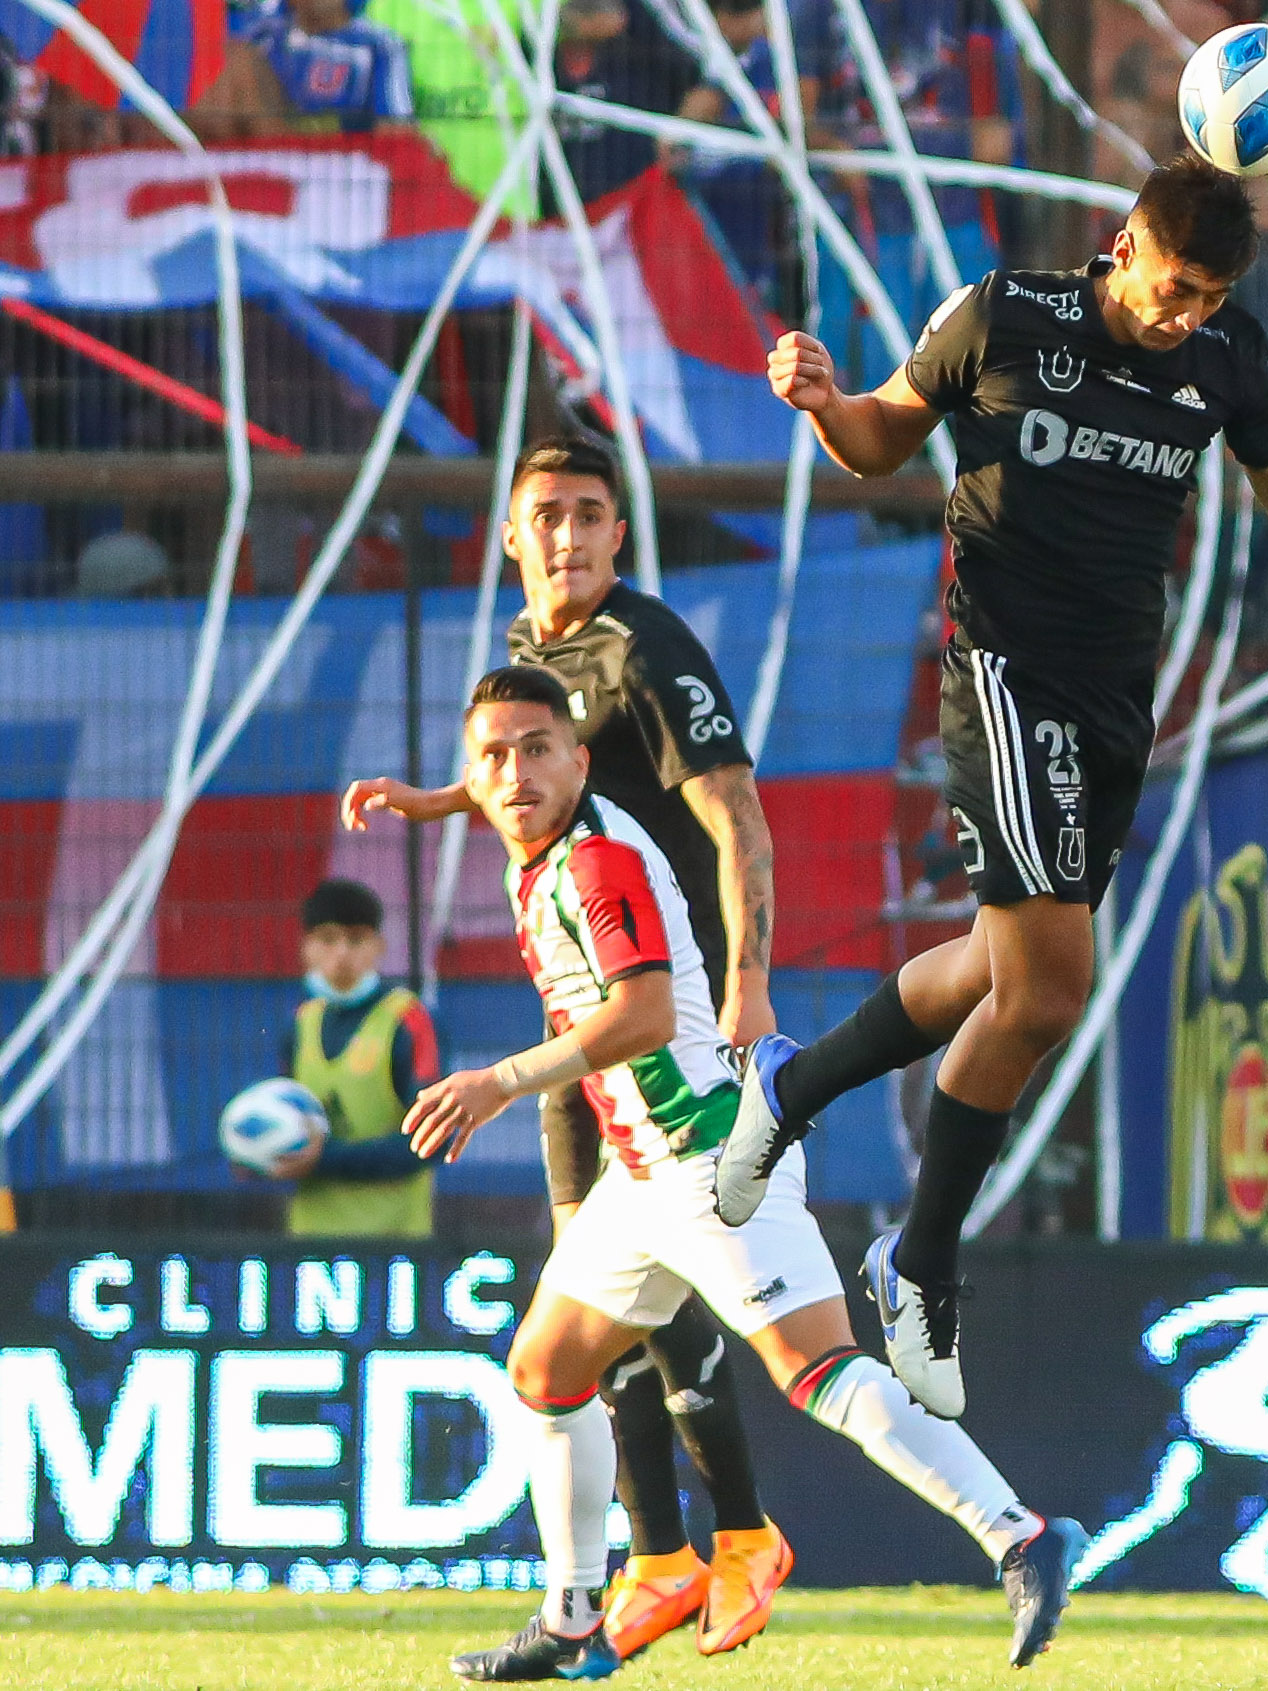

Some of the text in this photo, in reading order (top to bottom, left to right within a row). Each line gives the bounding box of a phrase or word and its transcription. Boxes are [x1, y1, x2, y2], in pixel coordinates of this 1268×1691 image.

[1005, 279, 1080, 308] DIRECTV
[1054, 306, 1083, 321] GO
[1068, 426, 1195, 479] BETANO
[0, 1346, 633, 1550] MED
